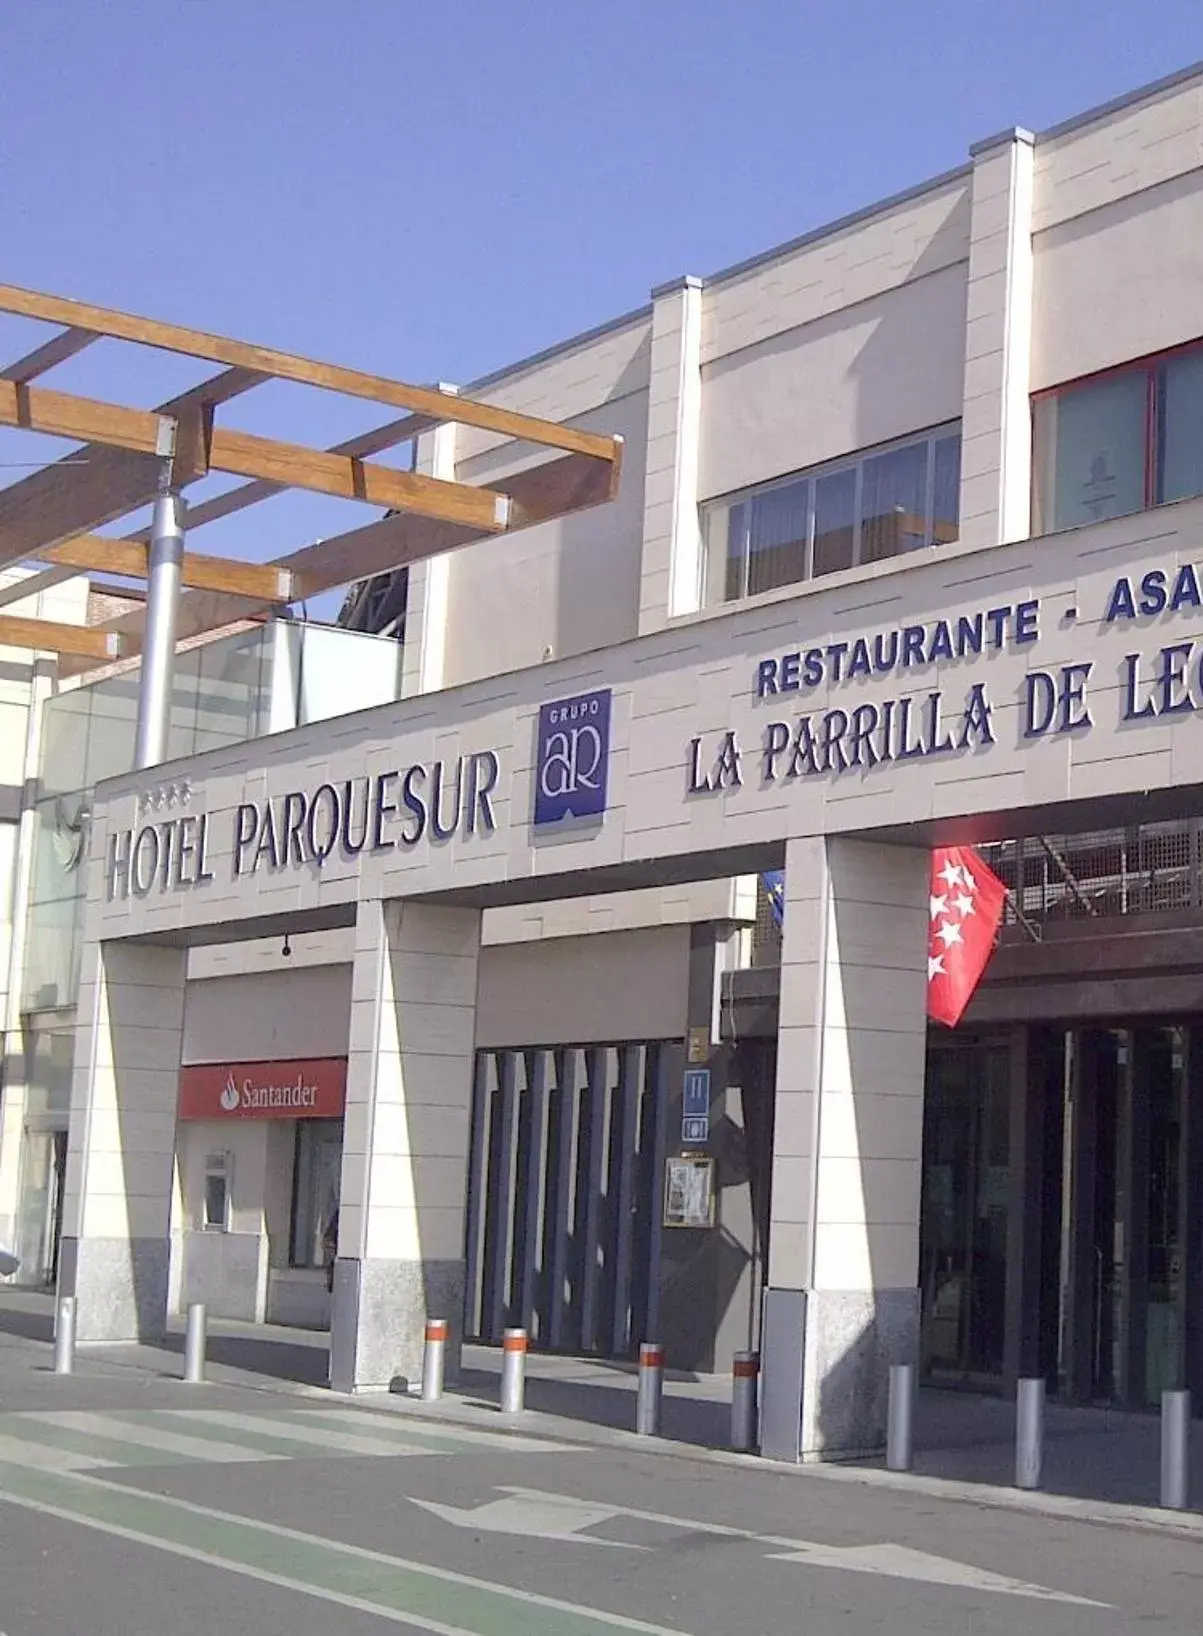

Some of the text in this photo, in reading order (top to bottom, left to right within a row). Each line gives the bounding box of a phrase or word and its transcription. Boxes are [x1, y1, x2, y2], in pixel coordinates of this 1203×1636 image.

[757, 599, 1039, 698] RESTAURANTE
[549, 700, 599, 723] GRUPO
[688, 730, 742, 793] LA
[763, 683, 996, 780] PARRILLA
[1023, 663, 1093, 740] DE
[104, 752, 498, 899] HOTEL PARQUESUR
[241, 1074, 318, 1108] Santander
